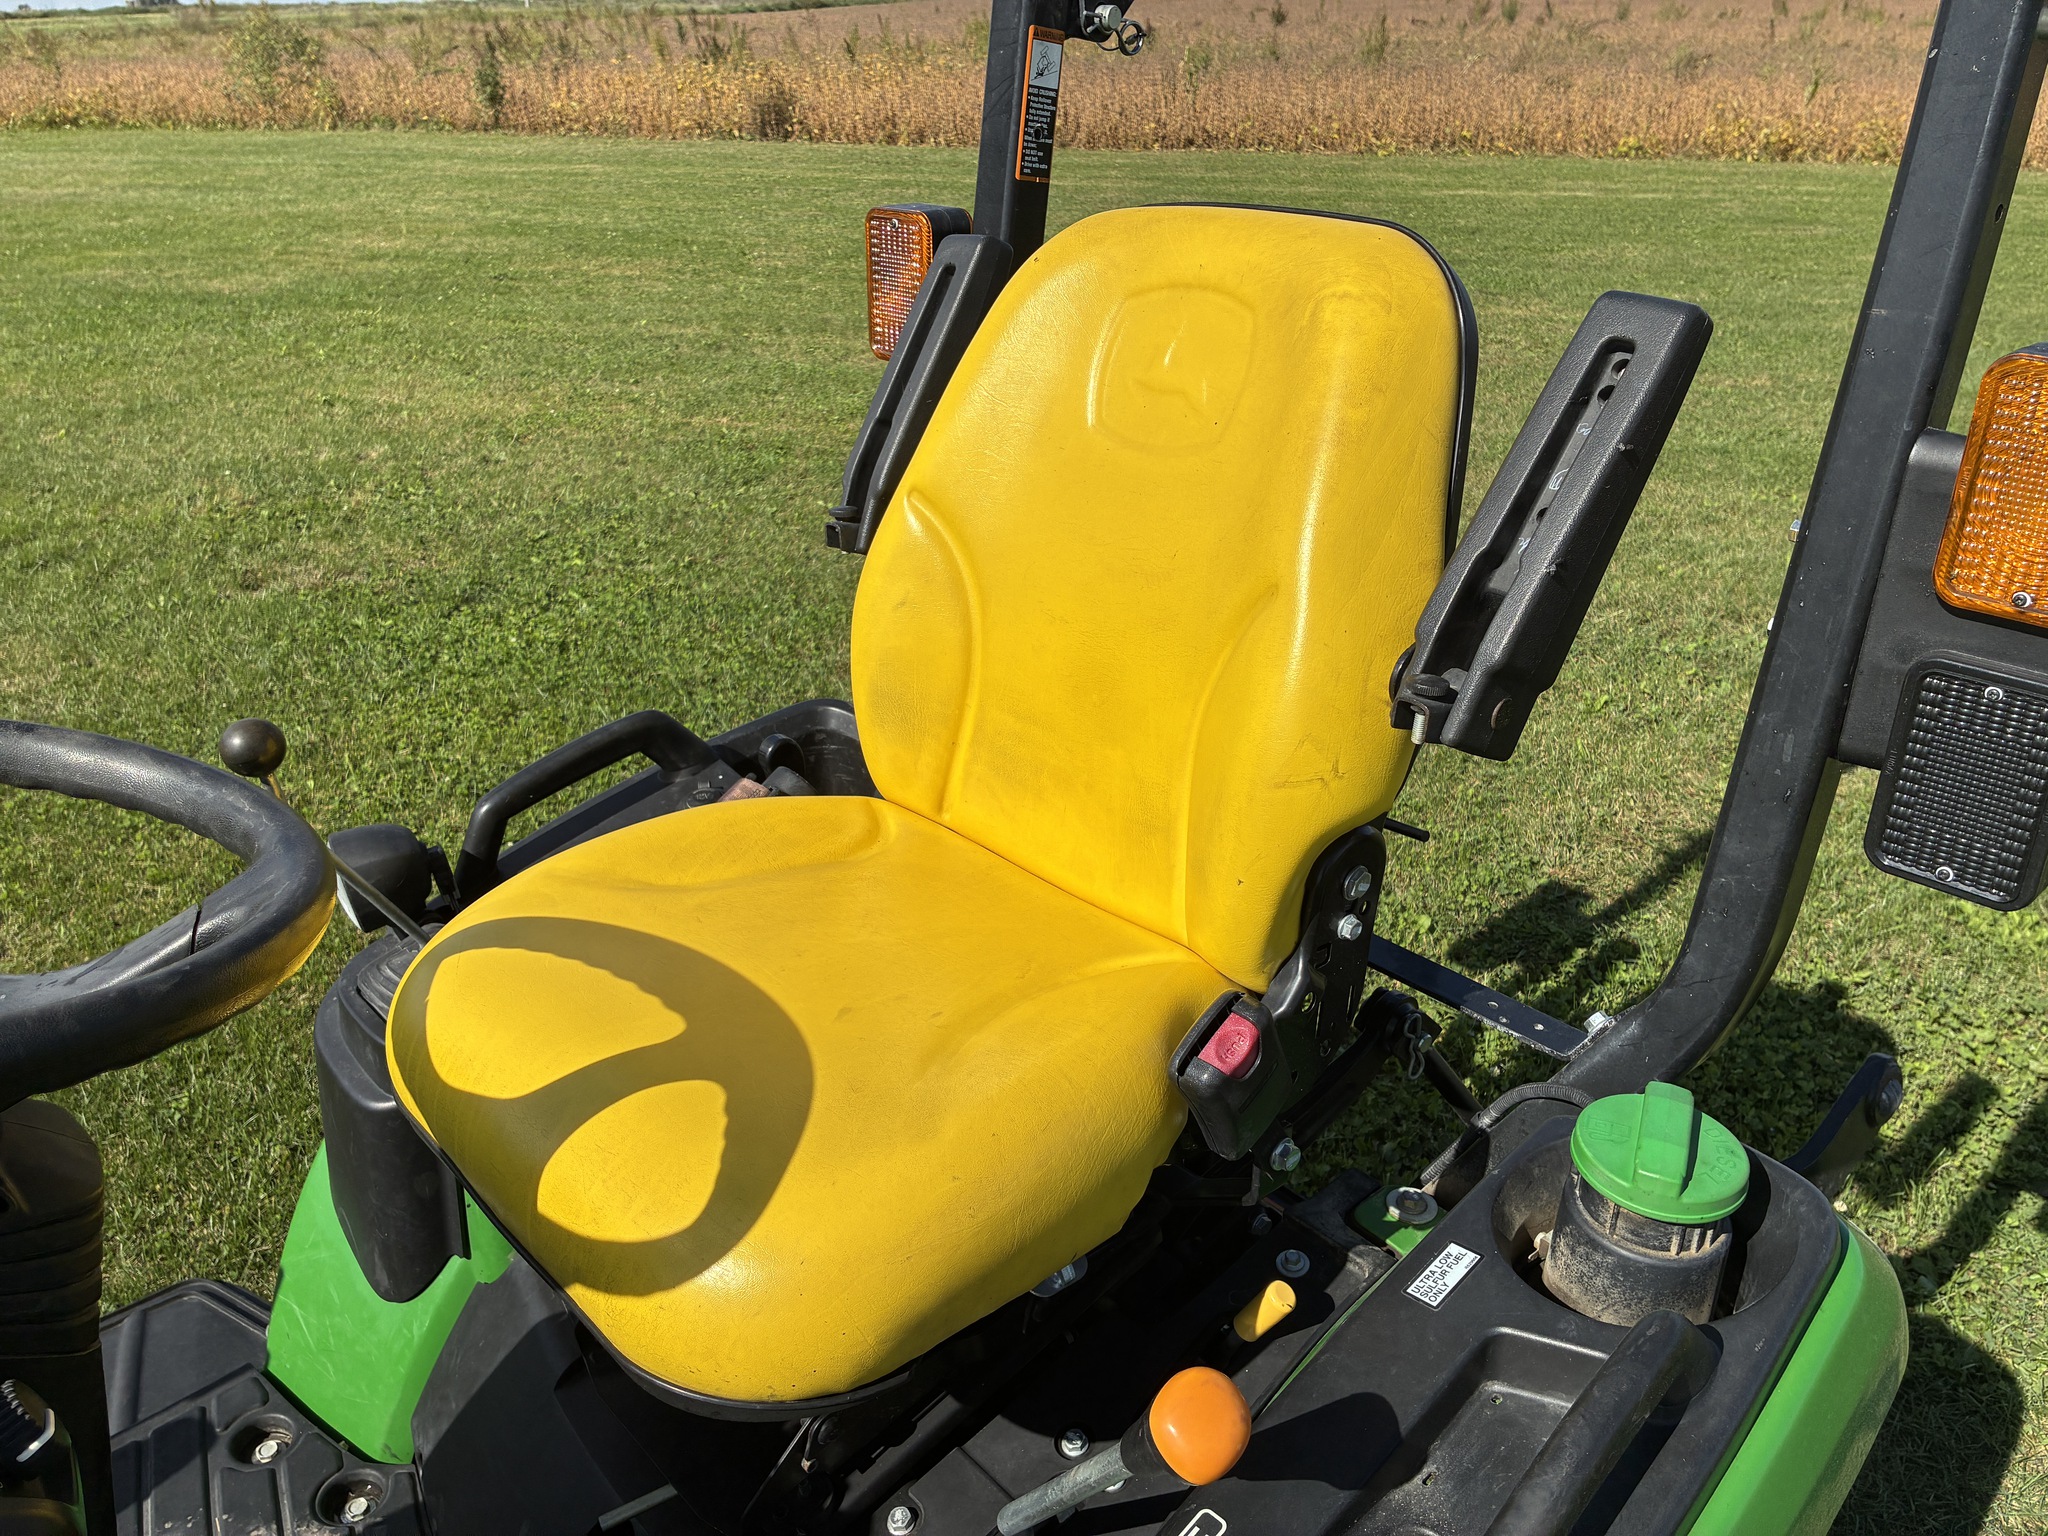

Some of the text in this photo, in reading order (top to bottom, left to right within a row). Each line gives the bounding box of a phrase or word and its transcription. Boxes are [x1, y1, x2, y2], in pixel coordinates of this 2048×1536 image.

[1699, 1127, 1737, 1184] DIESEL
[1411, 1251, 1453, 1294] ULTRA LOW
[1420, 1252, 1468, 1298] SULFUR FUEL
[1428, 1281, 1449, 1302] ONLY
